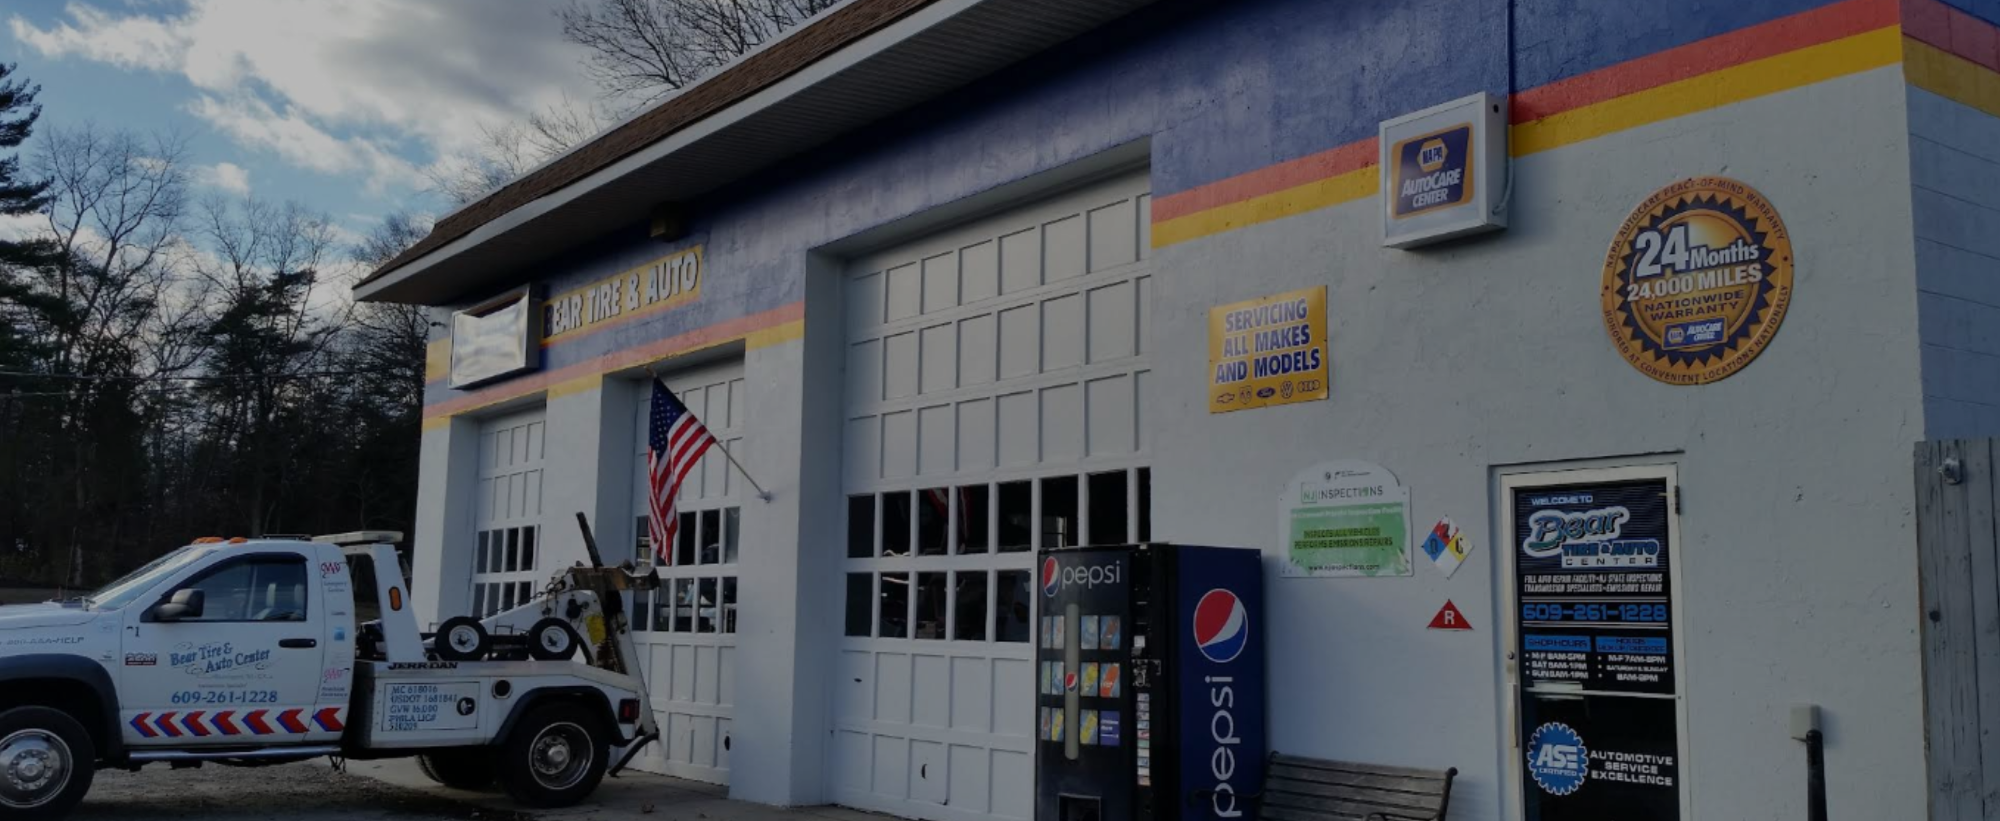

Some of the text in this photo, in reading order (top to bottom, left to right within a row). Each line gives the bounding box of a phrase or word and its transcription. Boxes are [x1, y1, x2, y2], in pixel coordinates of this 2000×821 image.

[1422, 146, 1443, 165] NAPA
[1412, 188, 1448, 207] CENTER
[1607, 240, 1622, 268] NAPA
[1620, 192, 1661, 238] AUTOCARE
[1746, 192, 1786, 240] WARRANTY
[1635, 225, 1760, 278] 24 Months
[587, 278, 622, 324] TIRE
[627, 272, 640, 311] &
[646, 251, 698, 304] AUTO
[1626, 263, 1763, 302] 24,000 MILES
[1644, 289, 1745, 312] NATIONWIDE
[1225, 298, 1308, 332] SERVICING
[1650, 301, 1739, 321] WARRANTY
[1223, 324, 1310, 358] ALL MAKES
[1604, 285, 1789, 383] HONORED AT CONVENIENT LOCATIONS NATIONALLY
[1215, 348, 1320, 384] AND MODELS
[1531, 494, 1594, 506] WELCOME TO
[1528, 510, 1624, 552] Bear
[1562, 543, 1598, 556] TIRE
[1611, 542, 1658, 556] AUTO
[1566, 557, 1653, 566] CENTER
[1062, 560, 1121, 590] pepsi
[1444, 610, 1455, 625] R
[1522, 603, 1668, 622] 609-261-1228
[170, 651, 198, 666] Bear
[198, 644, 222, 660] Tire
[223, 642, 233, 654] &
[206, 649, 270, 673] Auto Center
[171, 690, 278, 704] 609-261-1228
[390, 694, 421, 704] USDOT
[392, 685, 406, 694] MC
[390, 704, 410, 713] GVW
[1205, 675, 1243, 819] pepsi
[1536, 743, 1578, 770] ASE
[1589, 750, 1674, 766] AUTOMOTIVE
[1604, 761, 1658, 775] SERVICE
[1538, 768, 1578, 777] CERTIFIED
[1590, 770, 1673, 786] EXCELLENCE
